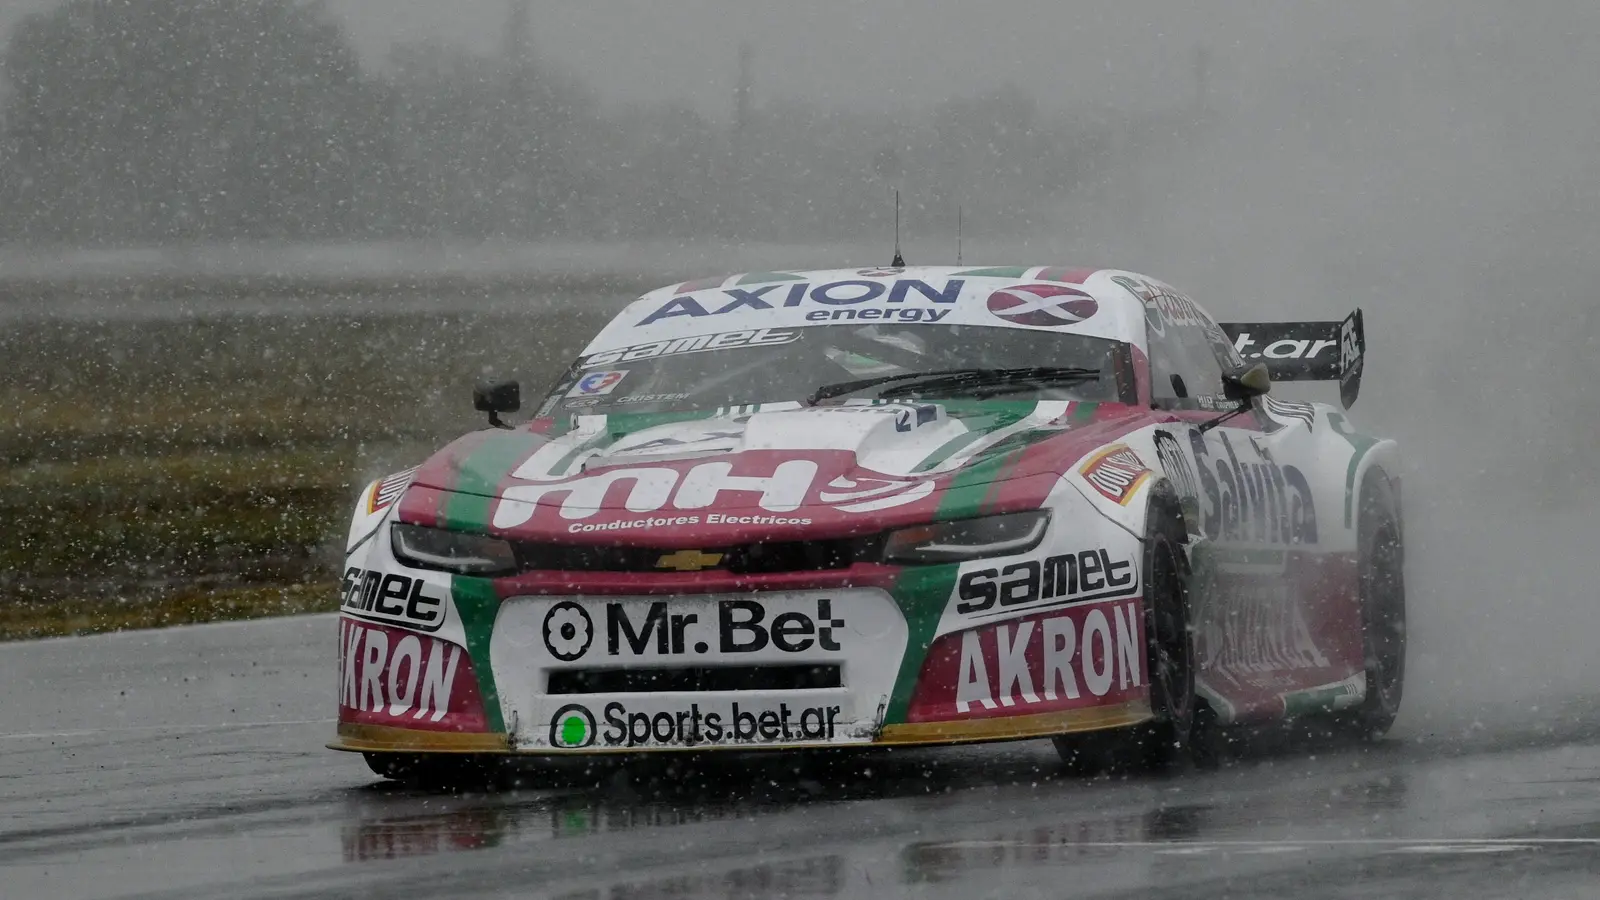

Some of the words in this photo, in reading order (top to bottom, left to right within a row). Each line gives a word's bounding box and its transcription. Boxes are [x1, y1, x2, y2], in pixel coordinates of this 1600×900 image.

[633, 279, 966, 327] AXION
[805, 308, 952, 323] energy
[568, 515, 700, 533] Conductores
[705, 513, 813, 526] Electricos
[955, 602, 1141, 713] AKRON
